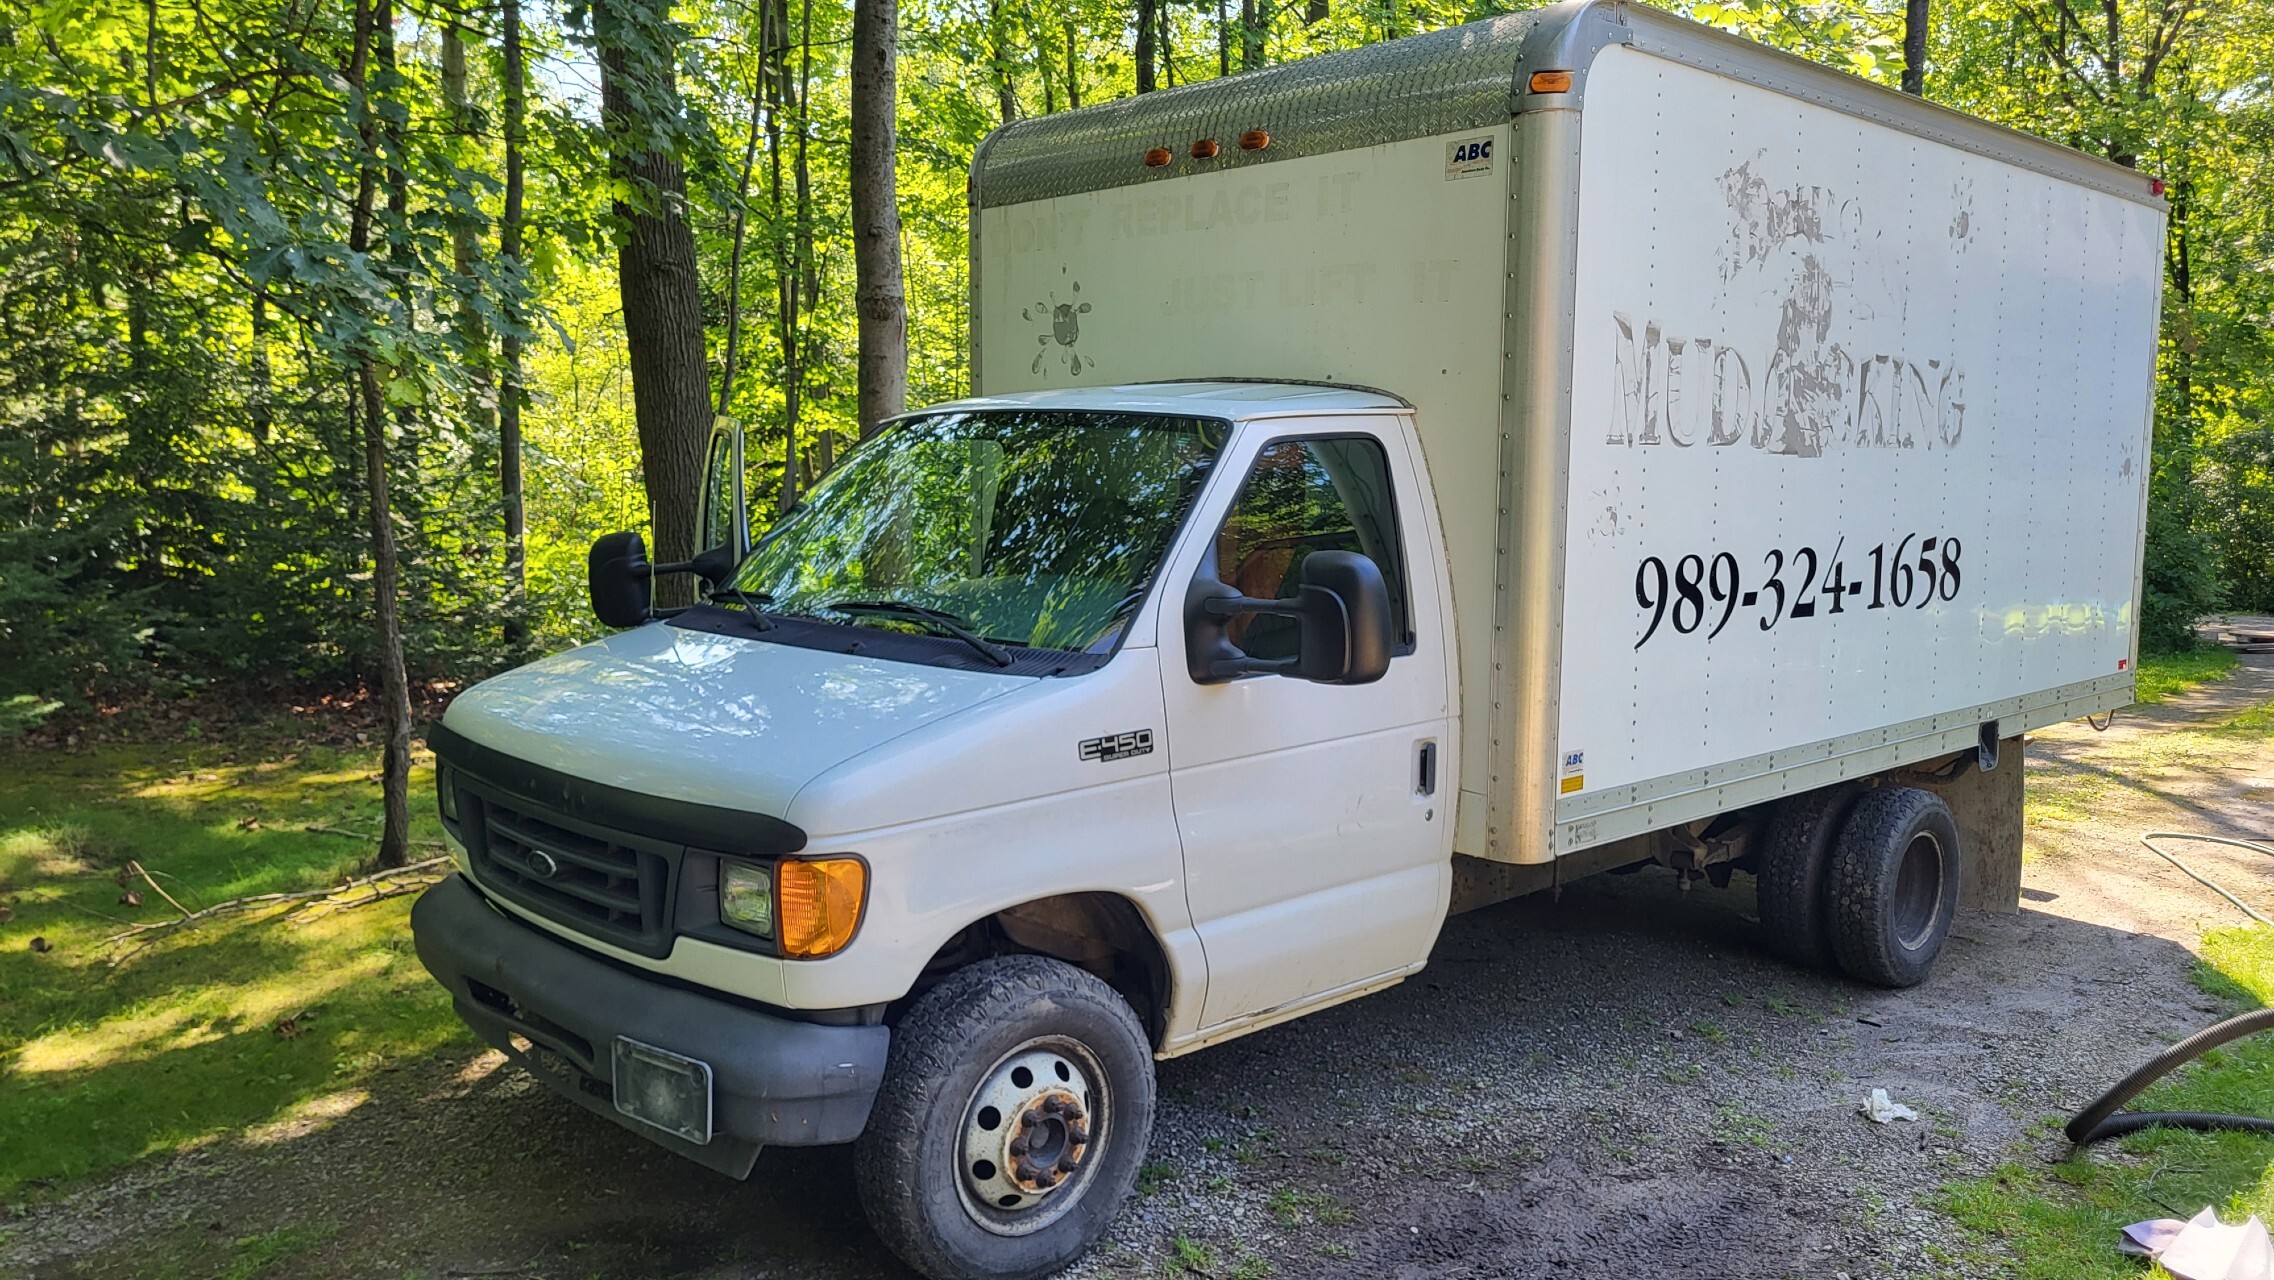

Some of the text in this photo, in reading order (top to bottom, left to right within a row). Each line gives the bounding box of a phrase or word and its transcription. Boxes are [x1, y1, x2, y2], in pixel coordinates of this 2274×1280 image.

[1453, 140, 1493, 163] ABC
[1111, 182, 1291, 241] REPLACE
[1317, 171, 1362, 217] IT
[1160, 259, 1462, 316] JUST LIFT IT
[1634, 532, 1963, 650] 989-324-1658
[1080, 730, 1152, 760] E-450
[1103, 746, 1151, 761] SUPER DUTY
[1566, 752, 1584, 767] ABC
